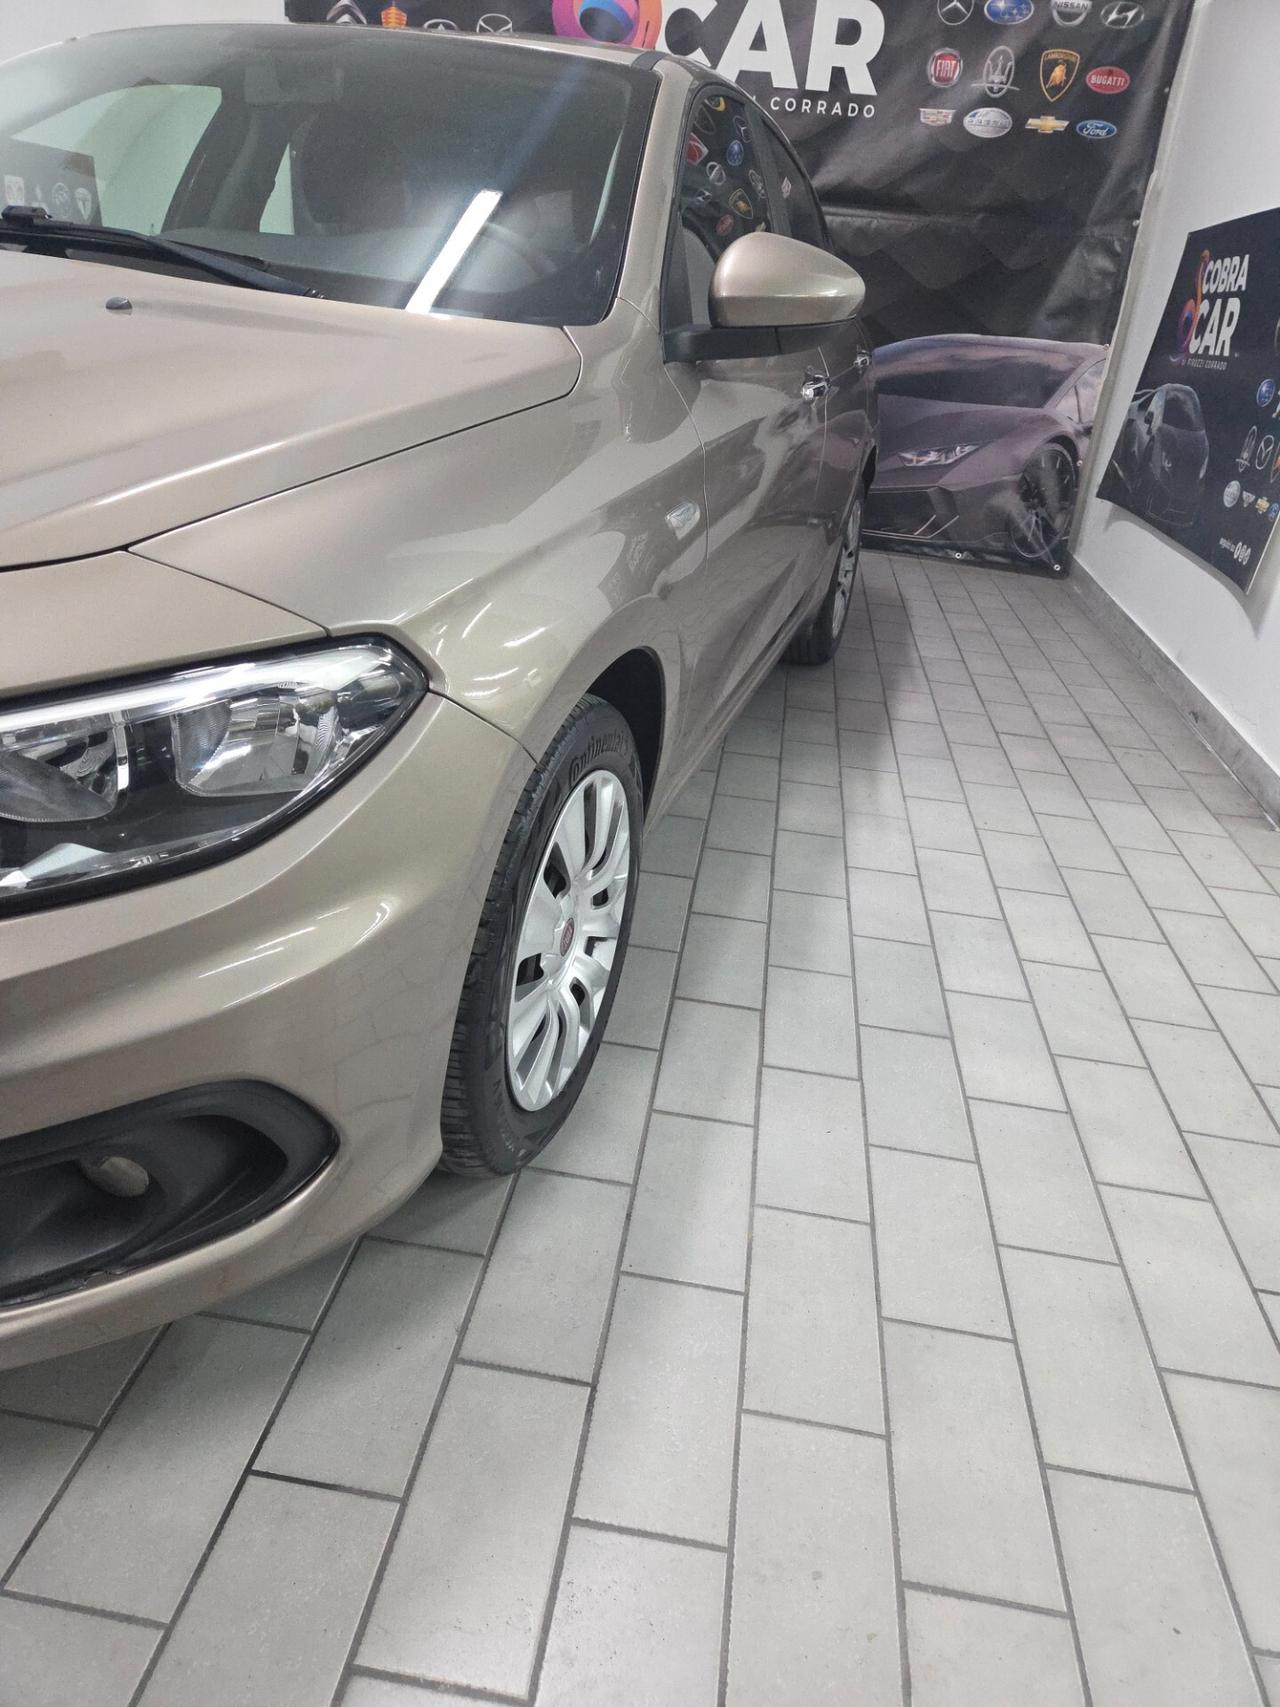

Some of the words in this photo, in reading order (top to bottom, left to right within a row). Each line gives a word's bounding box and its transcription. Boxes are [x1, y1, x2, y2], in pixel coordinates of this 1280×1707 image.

[1055, 0, 1089, 10] NISSAN
[655, 0, 885, 96] CAR
[936, 59, 957, 77] FIAT
[1090, 74, 1125, 86] BUGATTI
[770, 97, 875, 118] CORRADO
[1082, 122, 1109, 136] Ford
[1202, 254, 1250, 294] COBRA
[1188, 298, 1240, 356] CAR
